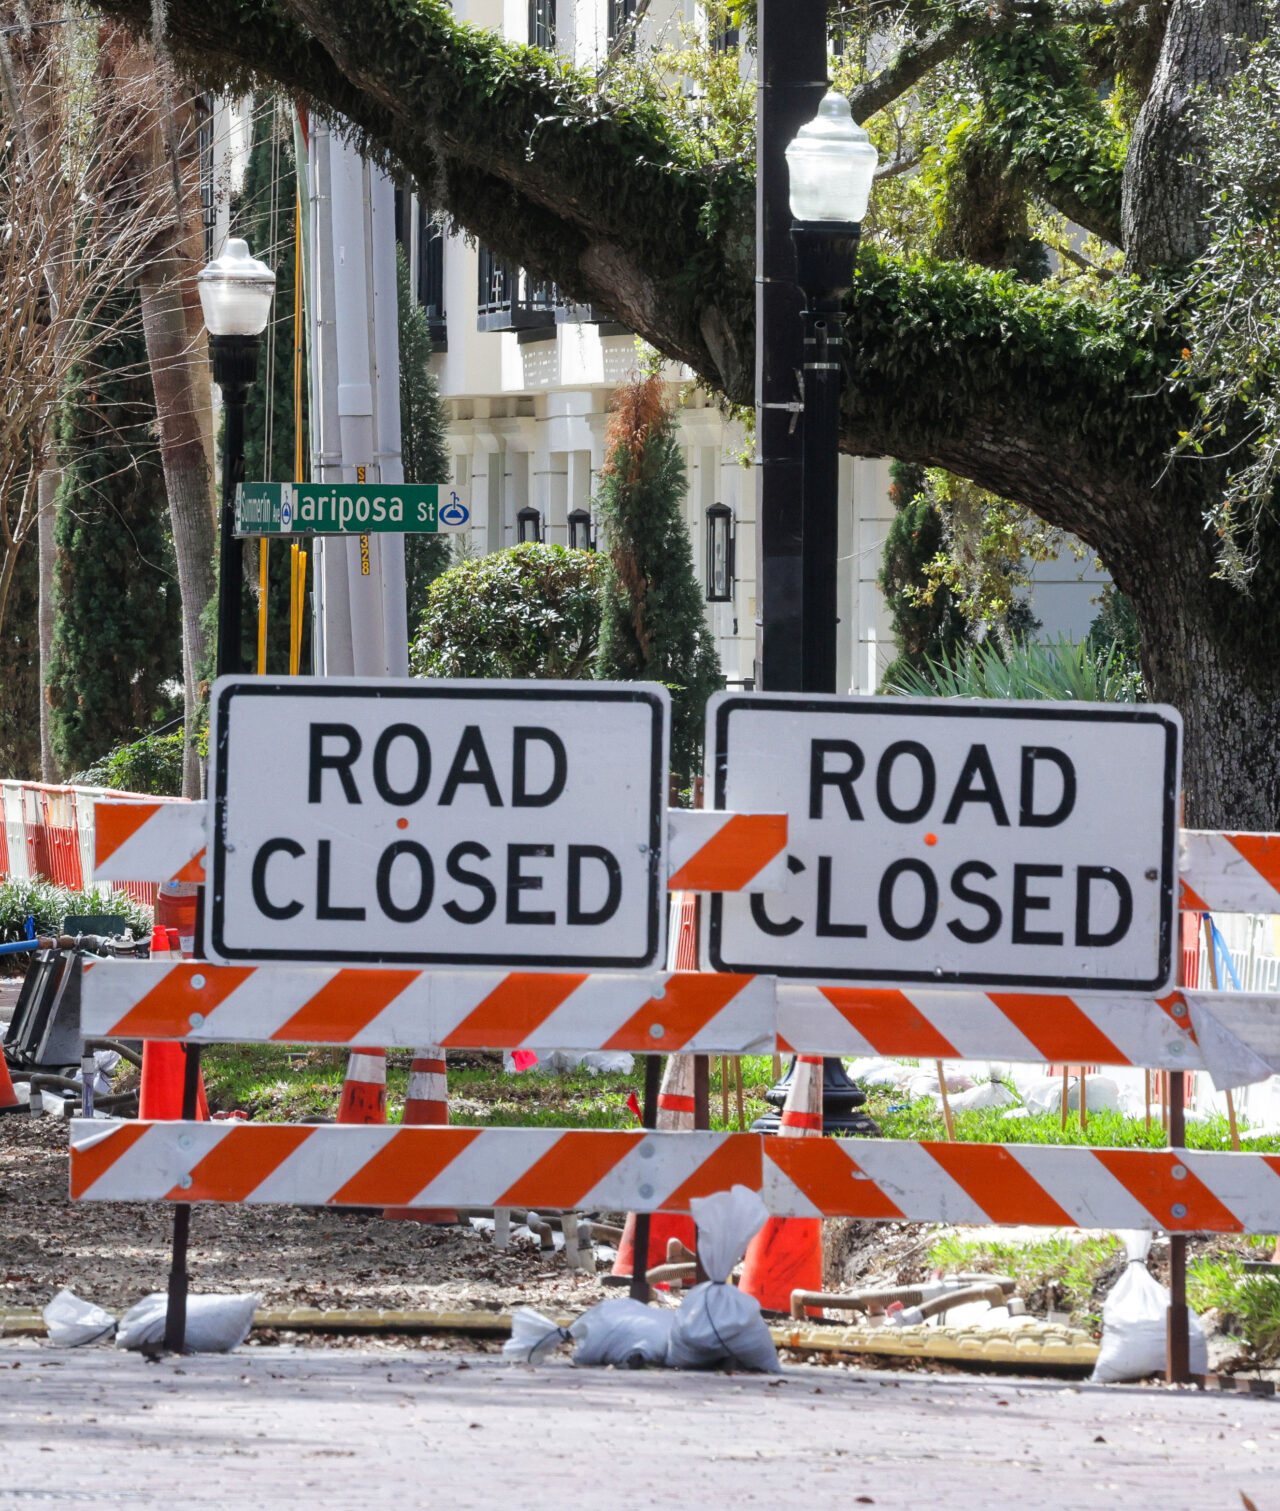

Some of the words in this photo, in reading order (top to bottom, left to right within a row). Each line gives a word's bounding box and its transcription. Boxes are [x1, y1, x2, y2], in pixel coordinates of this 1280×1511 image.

[417, 501, 435, 522] St
[307, 721, 569, 808] ROAD
[808, 737, 1078, 828] ROAD
[250, 837, 623, 926] CLOSED
[749, 854, 1135, 948] CLOSED
